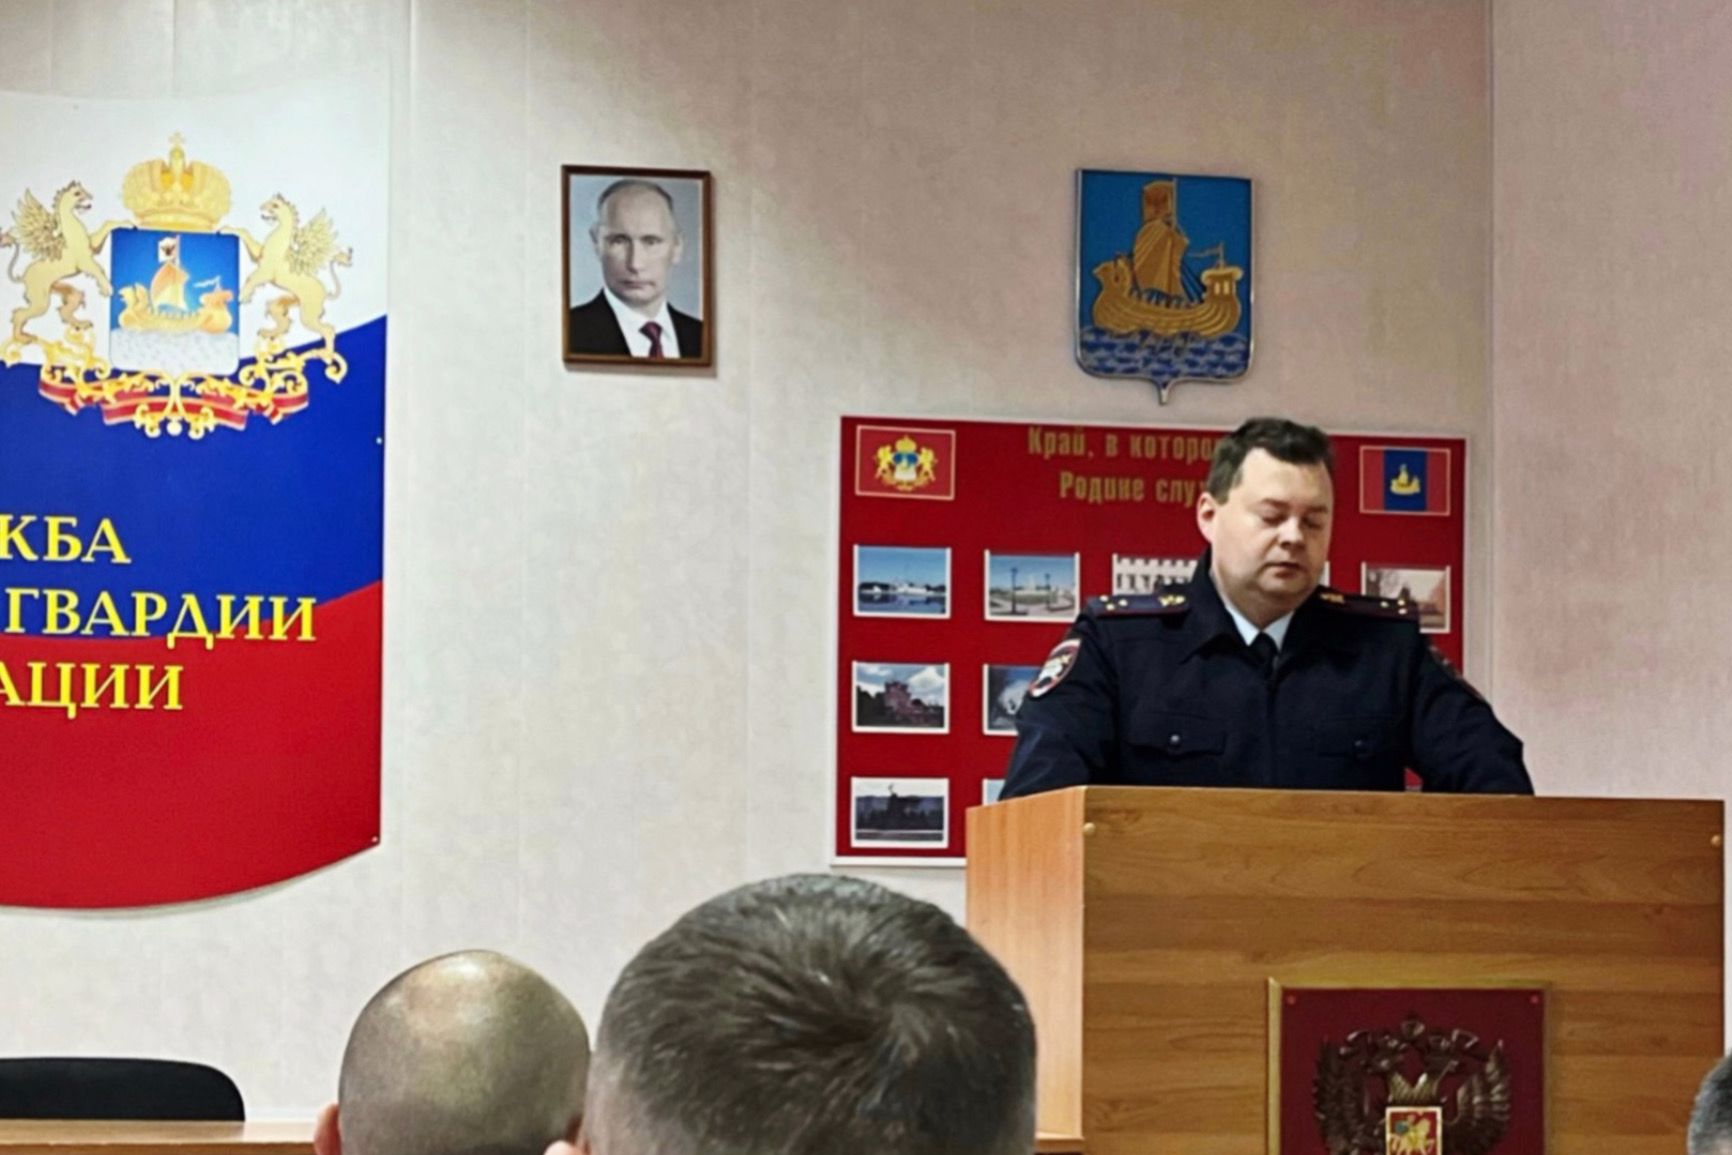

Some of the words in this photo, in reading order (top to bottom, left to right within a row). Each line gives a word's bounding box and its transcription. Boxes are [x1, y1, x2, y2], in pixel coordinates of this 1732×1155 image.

[1028, 426, 1094, 460] Край,
[1106, 434, 1118, 457] в
[1130, 435, 1219, 465] которо
[1060, 471, 1145, 504] Родине
[1156, 479, 1206, 508] слу
[5, 587, 317, 650] ГВАРДИИ
